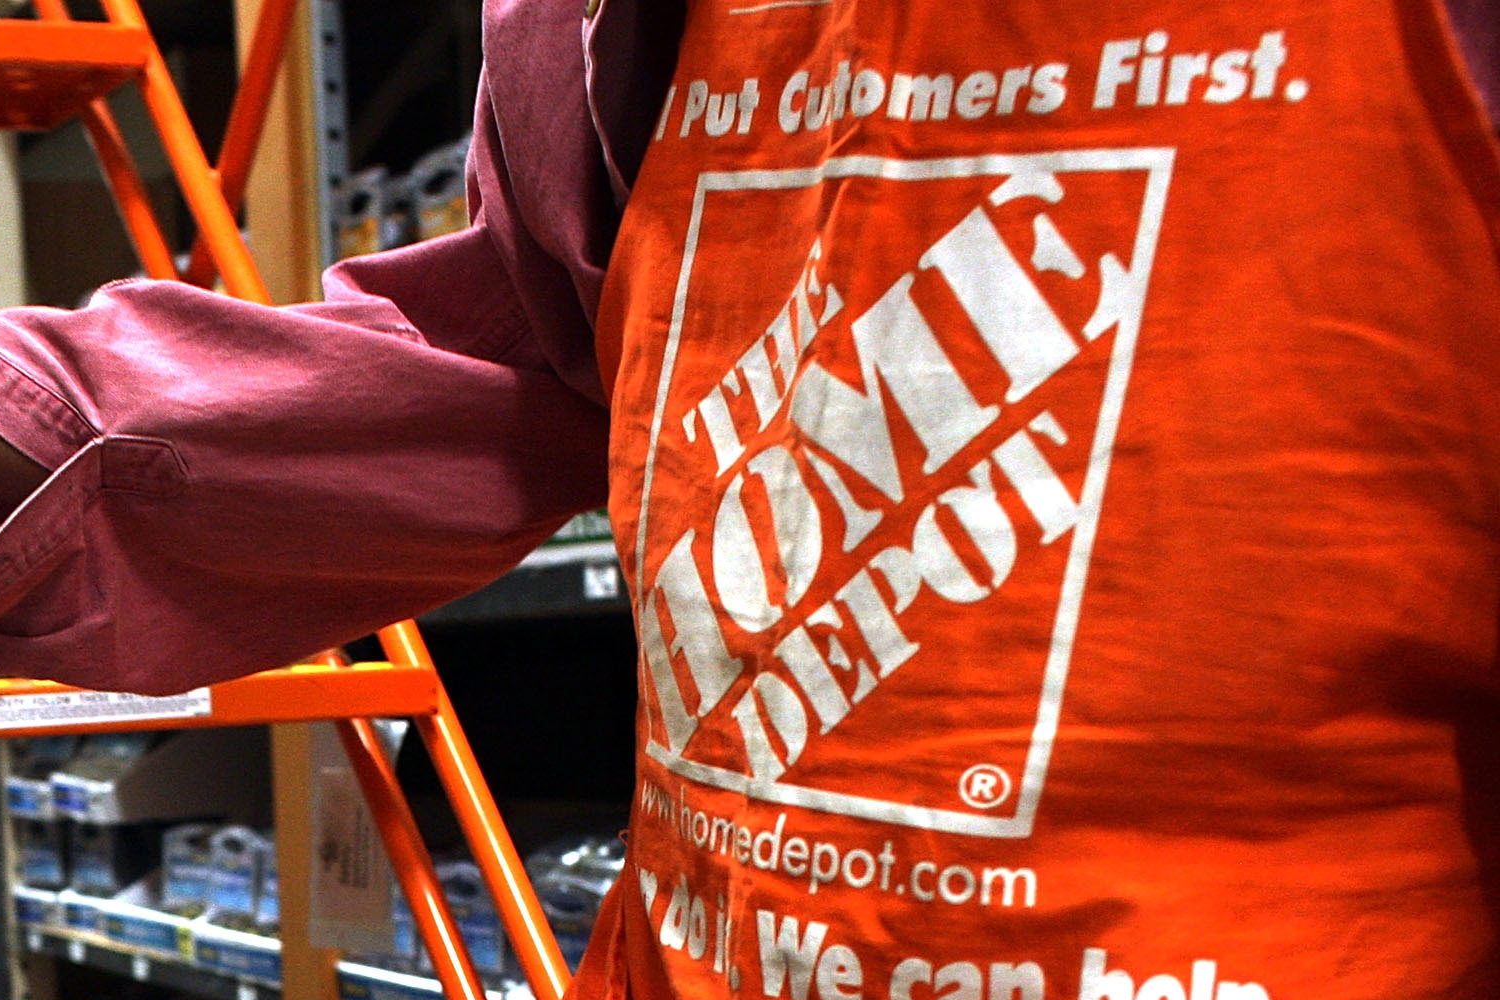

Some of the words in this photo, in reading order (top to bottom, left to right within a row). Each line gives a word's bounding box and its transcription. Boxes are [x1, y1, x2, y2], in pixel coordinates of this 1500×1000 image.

[679, 79, 760, 138] Put
[777, 60, 1068, 133] Cutomers
[1092, 30, 1309, 109] First.
[642, 171, 1134, 758] HOME
[683, 237, 845, 478] THE
[730, 410, 1083, 782] DEPOT
